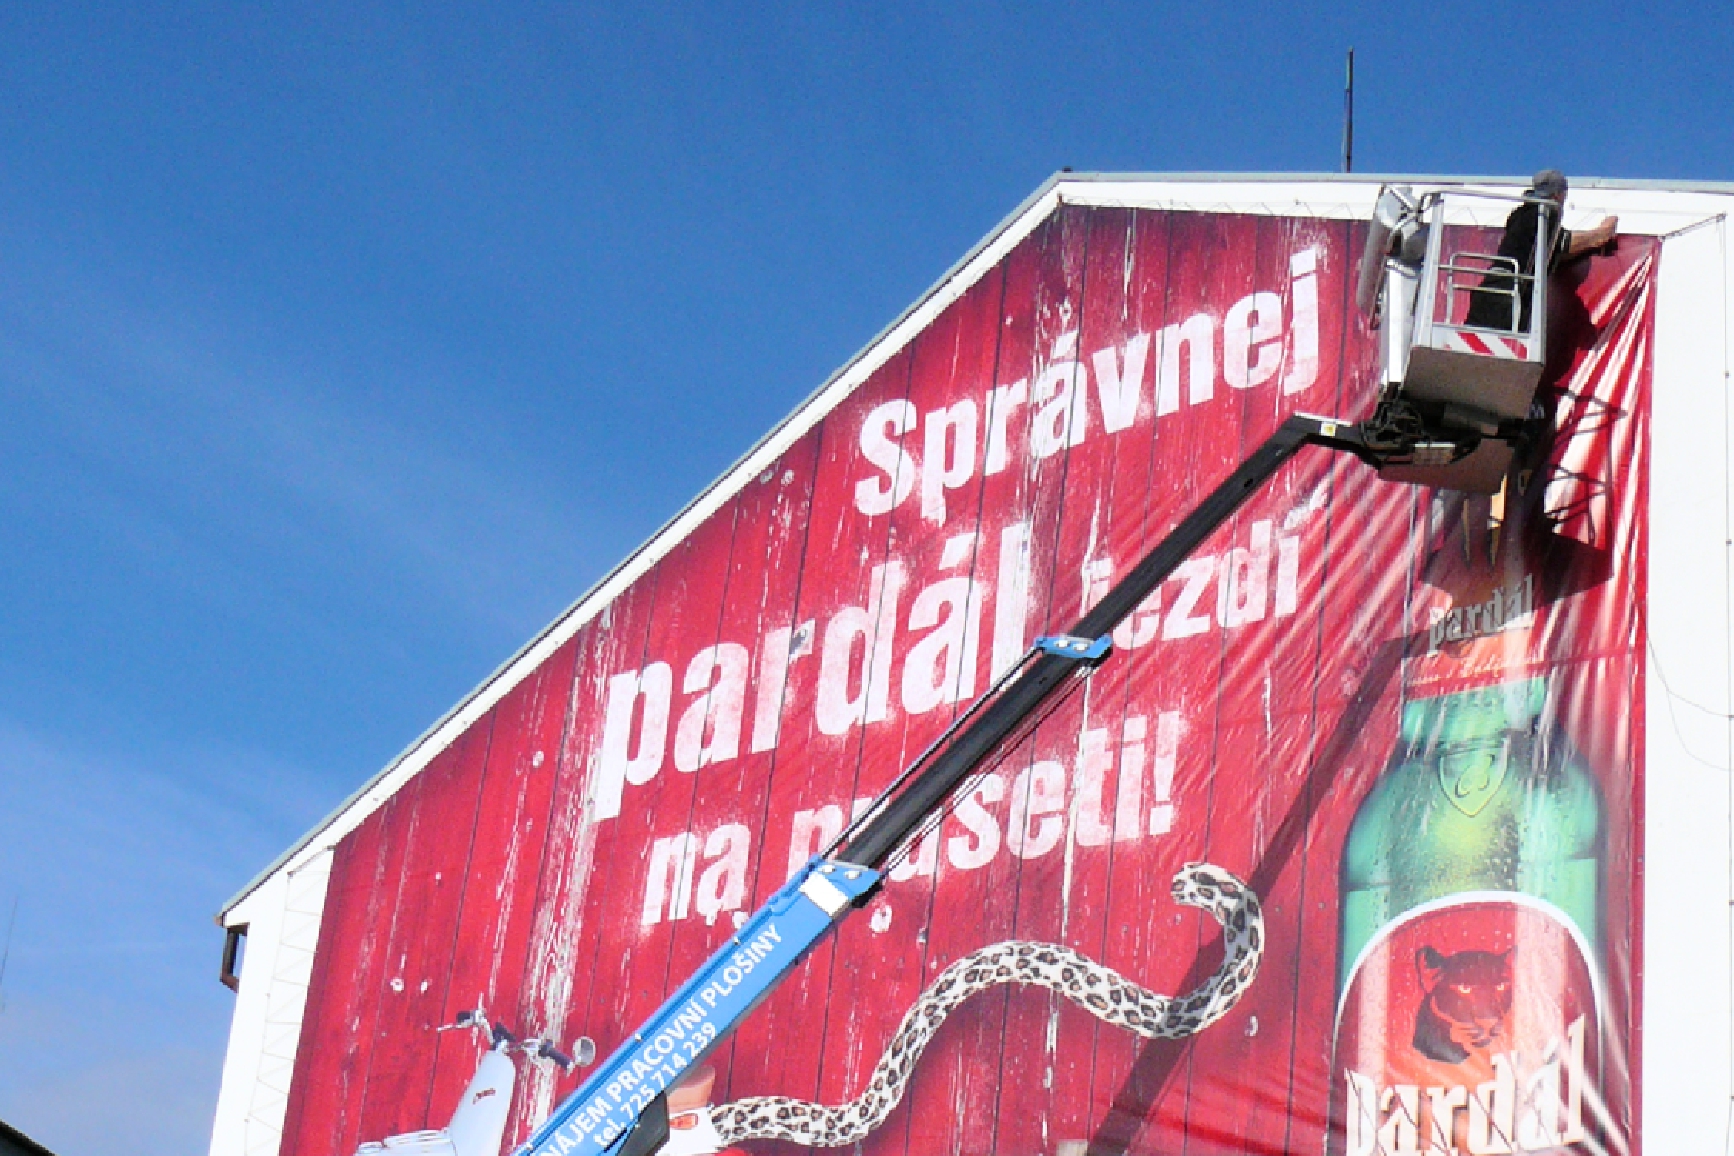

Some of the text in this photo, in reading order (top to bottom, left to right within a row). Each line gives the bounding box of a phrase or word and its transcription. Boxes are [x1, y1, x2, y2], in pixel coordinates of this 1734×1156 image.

[854, 247, 1319, 526] Správnej
[592, 520, 1032, 822] pardál
[1427, 573, 1533, 658] pardál
[643, 820, 752, 925] na
[593, 1021, 718, 1147] tel. 725 714 239
[608, 998, 709, 1104] PRACOVNÍ
[701, 924, 783, 1010] PLOŠINY
